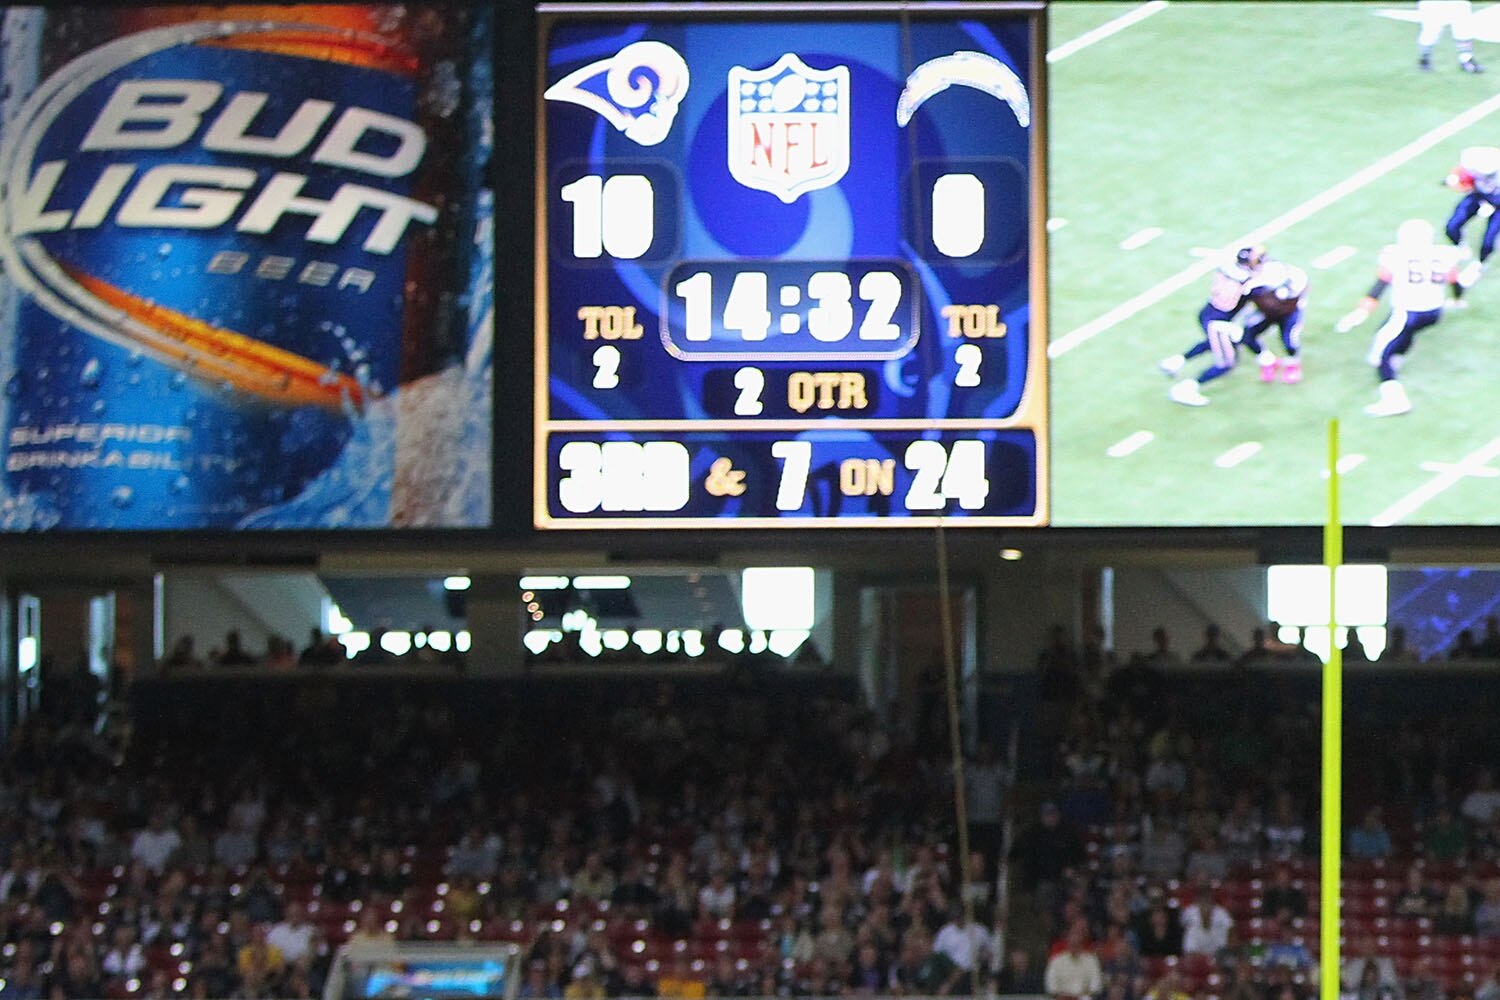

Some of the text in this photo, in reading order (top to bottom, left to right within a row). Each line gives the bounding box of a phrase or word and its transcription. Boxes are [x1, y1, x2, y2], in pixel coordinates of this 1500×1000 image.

[79, 78, 428, 179] BUD
[749, 121, 830, 174] NFL
[14, 158, 439, 255] LIGHT
[560, 174, 655, 260] 10
[931, 172, 986, 258] 0
[206, 250, 377, 295] BEER
[577, 305, 645, 341] TOL
[675, 271, 902, 343] 14:32
[941, 304, 1007, 339] TOL
[592, 344, 622, 390] 2
[733, 366, 869, 417] 2 QTR
[953, 343, 984, 388] 2
[704, 456, 748, 497] &
[771, 440, 812, 512] 7
[839, 458, 895, 496] ON
[904, 440, 990, 511] 24
